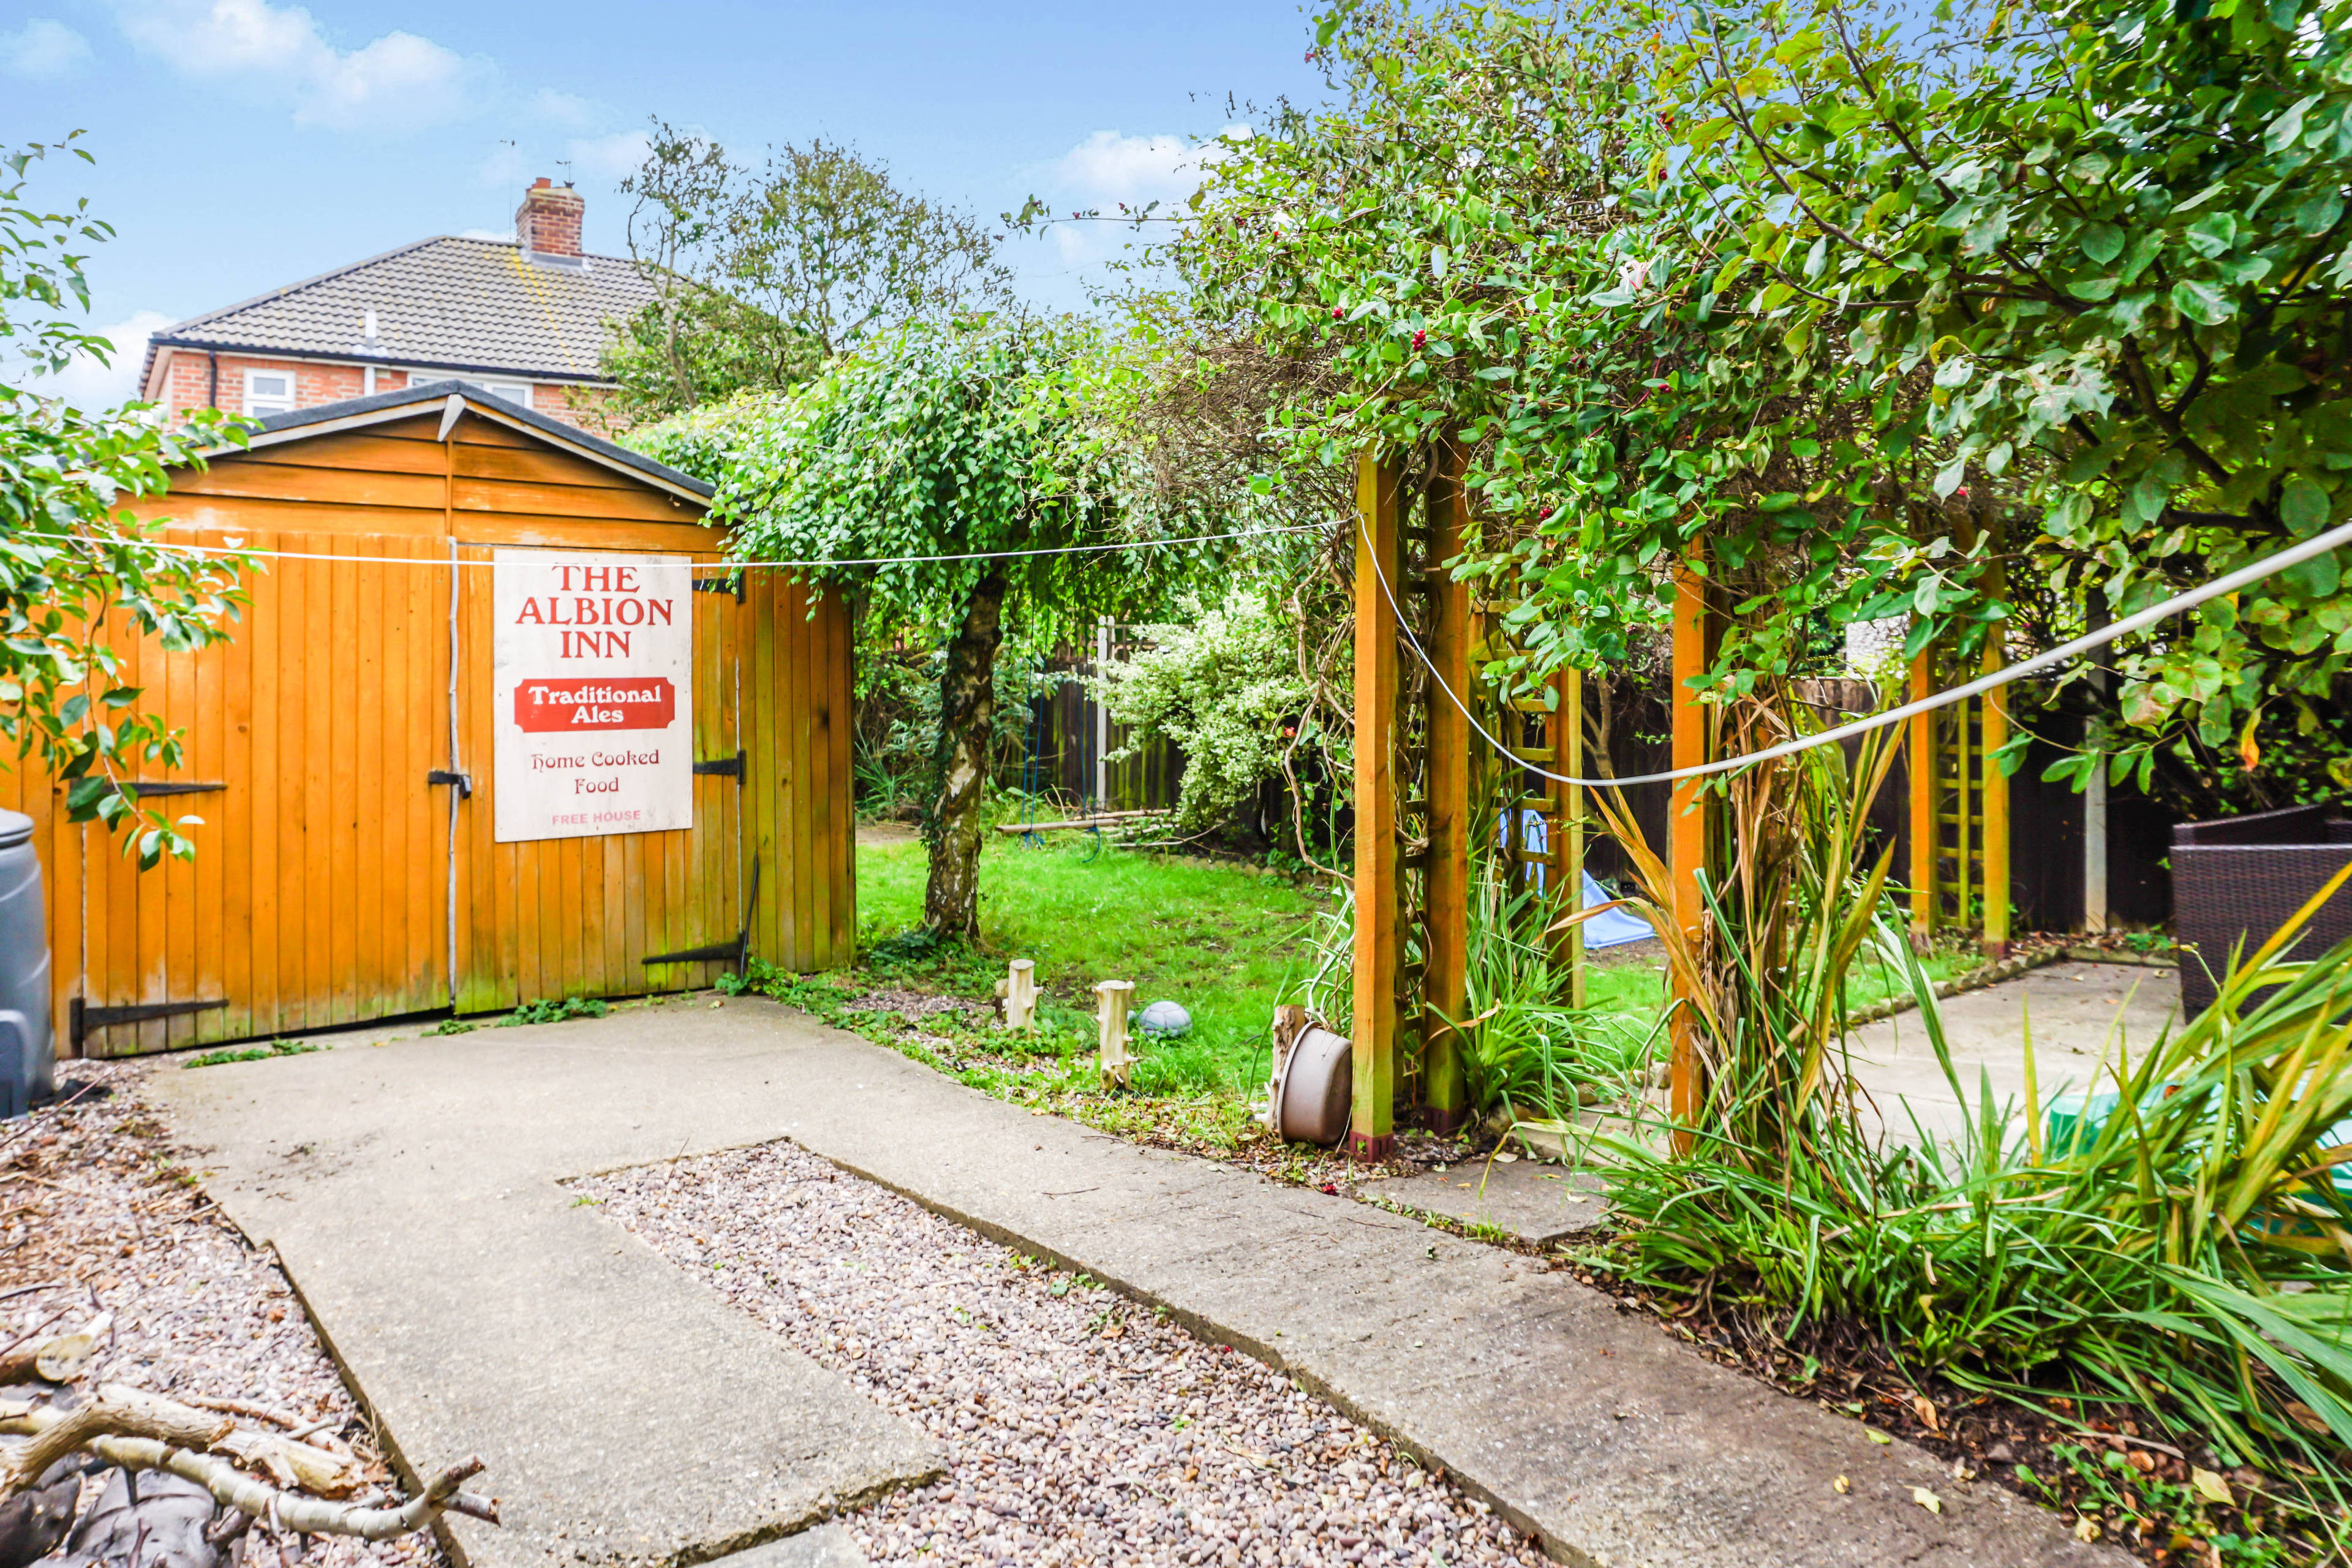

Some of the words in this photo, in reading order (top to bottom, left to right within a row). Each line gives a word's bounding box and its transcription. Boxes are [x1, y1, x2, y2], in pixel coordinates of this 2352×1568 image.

[552, 563, 639, 593] THE
[515, 597, 673, 625] ALBION
[561, 631, 630, 658] INN
[528, 685, 662, 705] Traditional
[571, 706, 624, 723] Ales
[531, 753, 585, 772] Home
[592, 750, 658, 766] Cooked
[575, 778, 619, 794] Food
[552, 813, 587, 825] FREE
[594, 810, 640, 822] HOUSE
